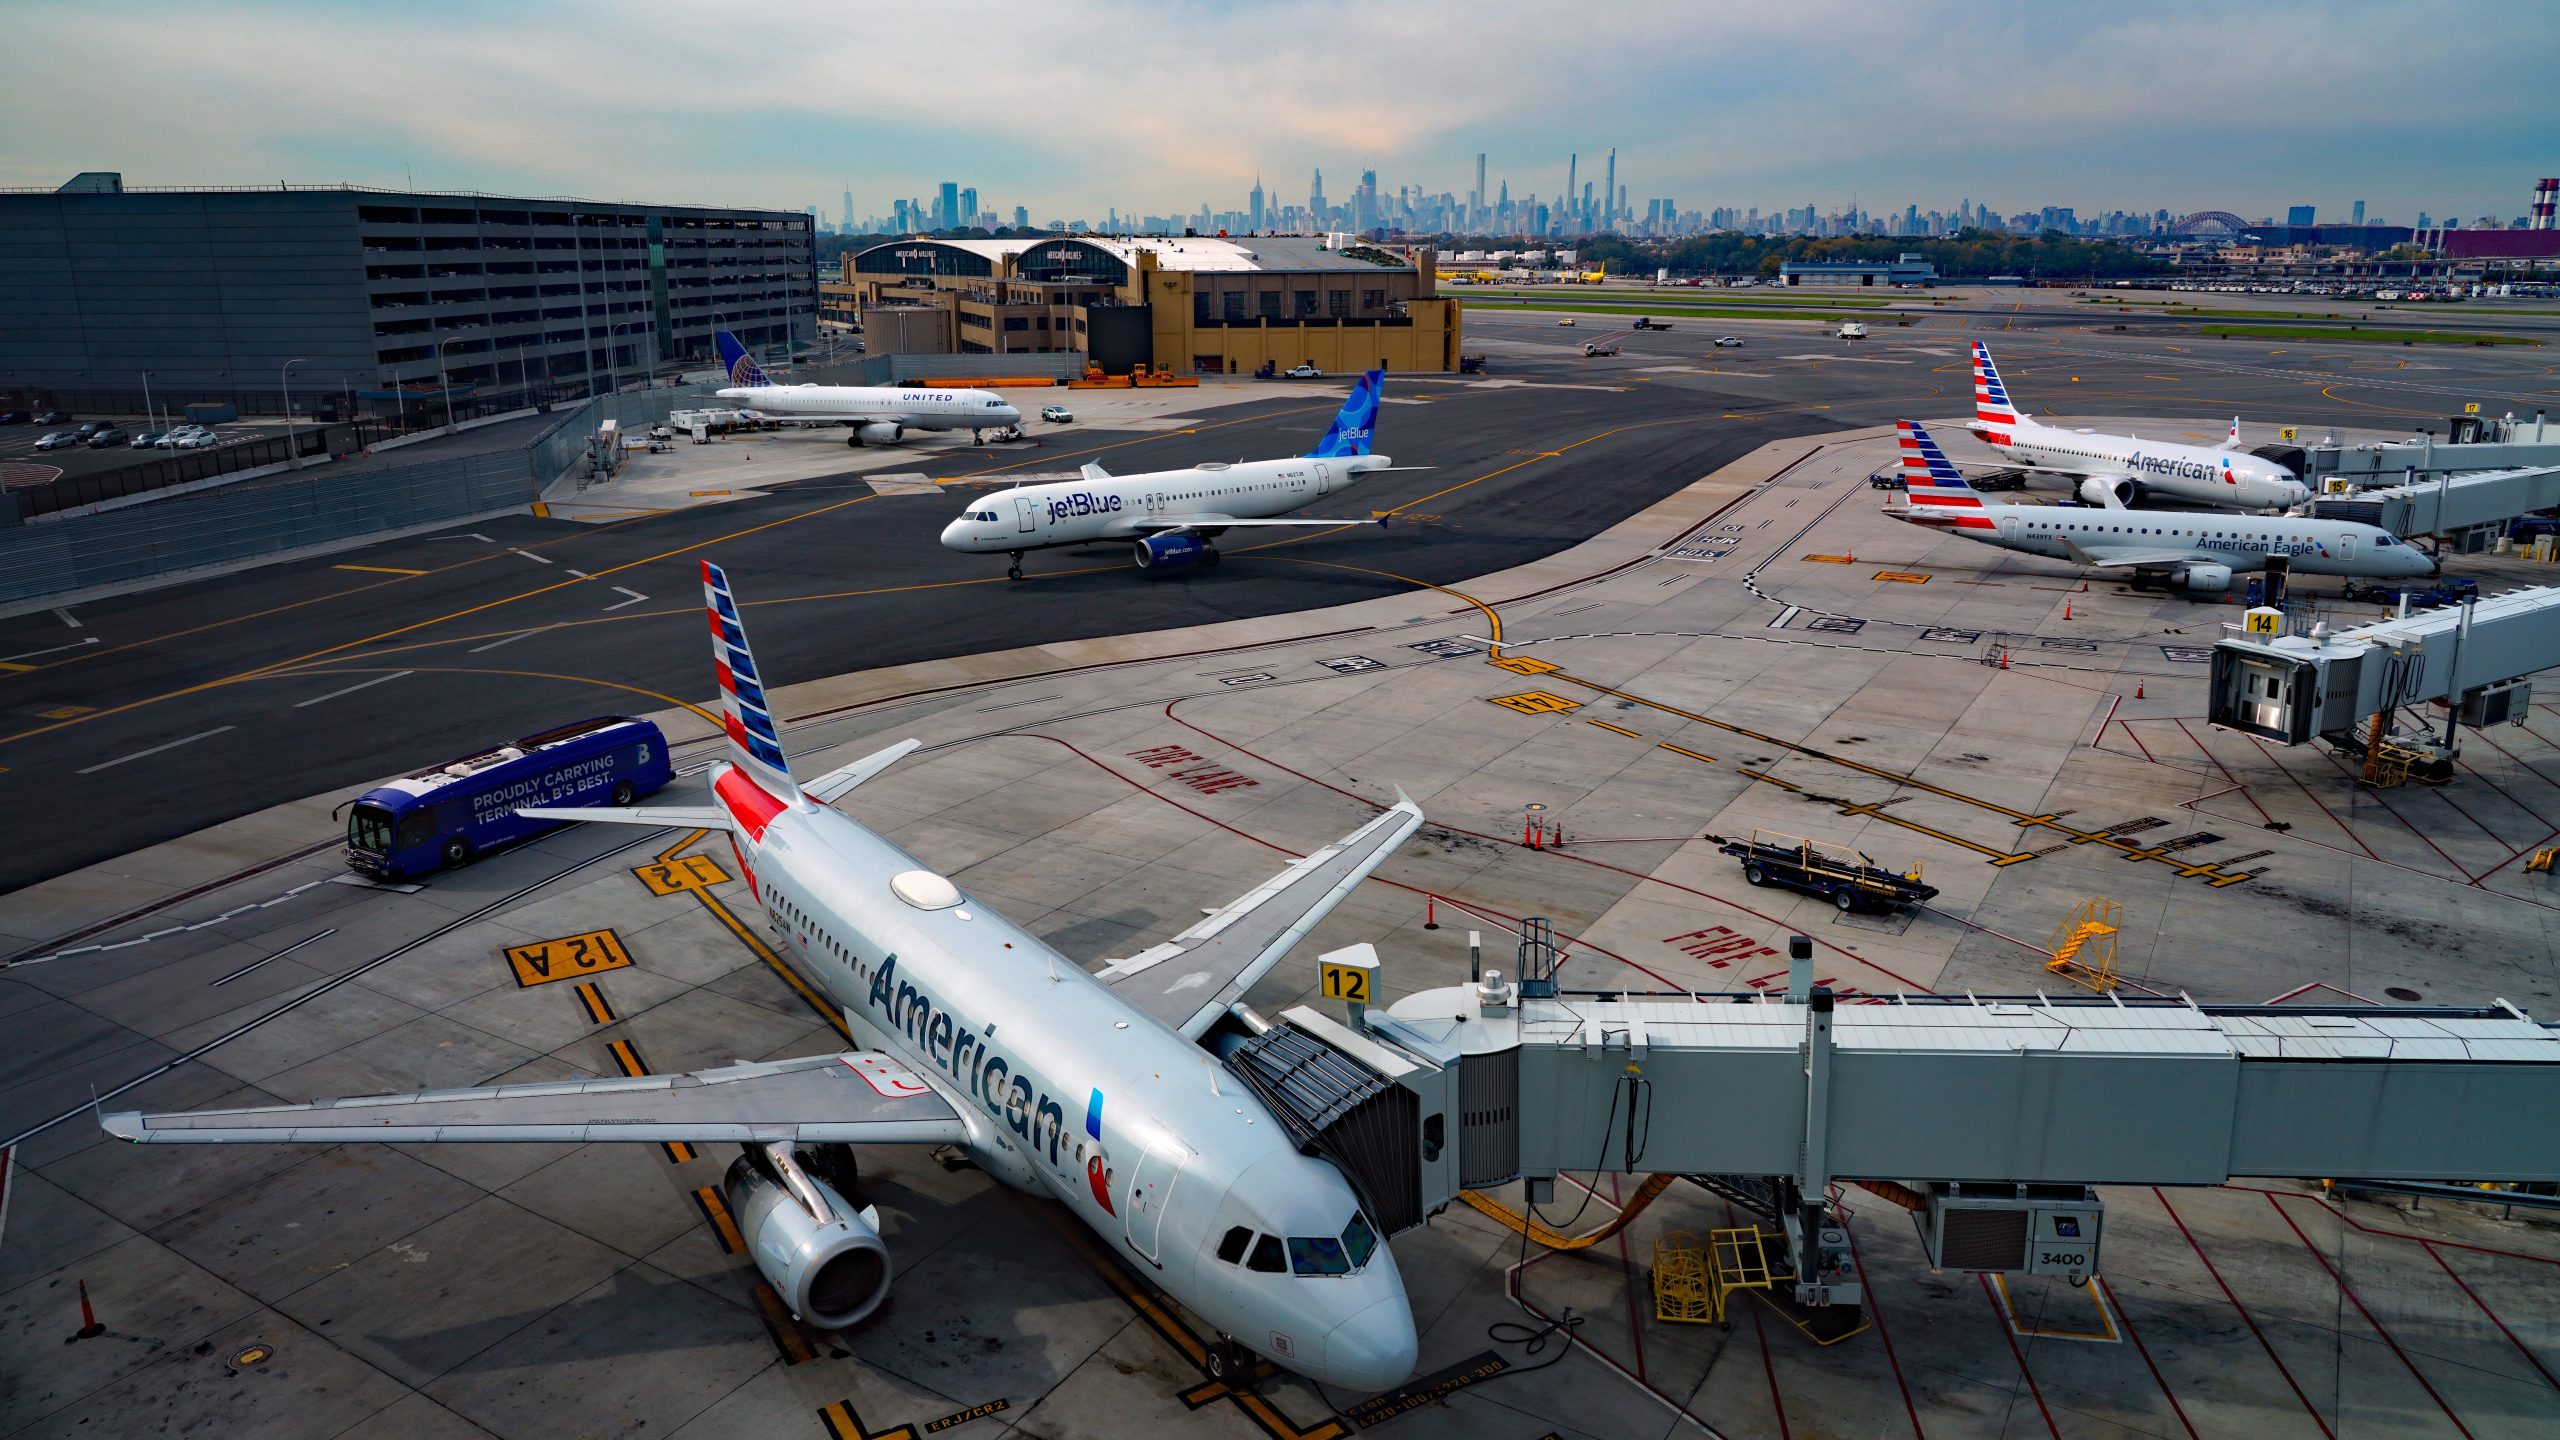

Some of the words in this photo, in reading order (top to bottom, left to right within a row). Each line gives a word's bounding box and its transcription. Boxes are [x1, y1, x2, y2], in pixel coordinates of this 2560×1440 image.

[903, 393, 953, 402] UNITED
[2467, 404, 2476, 412] 17
[1339, 427, 1369, 442] jetBlue
[2284, 429, 2293, 439] 16
[2127, 451, 2216, 482] American
[2331, 481, 2343, 492] 15
[1046, 492, 1122, 525] jetBlue
[2196, 538, 2269, 552] American
[2274, 541, 2314, 557] Eagle
[2254, 614, 2272, 633] 14
[638, 743, 650, 766] B
[1126, 744, 1204, 768] FIRE
[473, 778, 540, 811] PROUDLY
[544, 755, 614, 787] CARRYING
[1168, 764, 1260, 795] LANE
[475, 793, 550, 825] TERMINAL
[578, 771, 614, 794] BEST.
[651, 861, 708, 889] 12
[1662, 925, 1780, 969] FIRE
[1327, 968, 1365, 1000] 12
[868, 952, 1063, 1167] American
[2041, 1253, 2085, 1266] 3400
[930, 1400, 1006, 1431] ERJ/CR2
